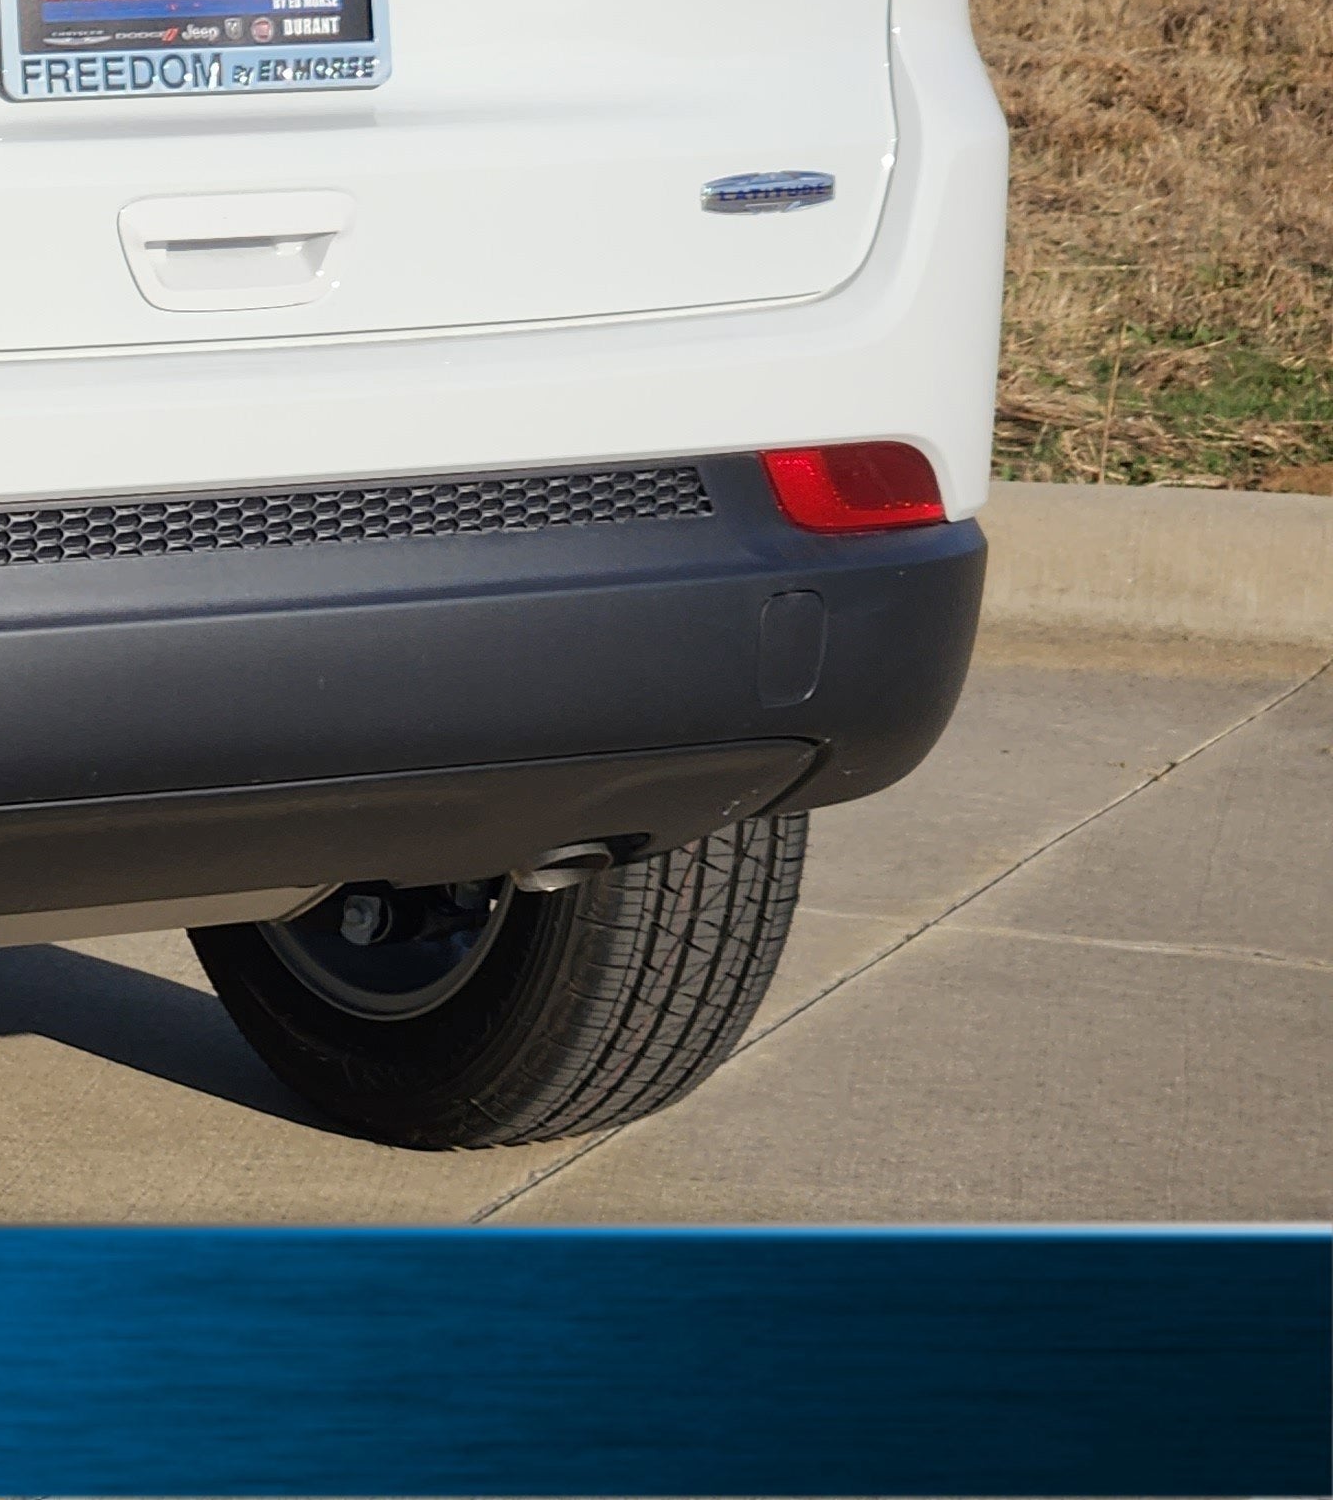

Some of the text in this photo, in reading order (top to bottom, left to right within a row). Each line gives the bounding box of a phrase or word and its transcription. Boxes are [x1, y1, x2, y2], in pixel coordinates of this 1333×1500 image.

[181, 23, 221, 42] Jeep
[282, 15, 342, 36] DURANT
[20, 52, 224, 95] FREEDOM
[292, 55, 377, 81] MORSE
